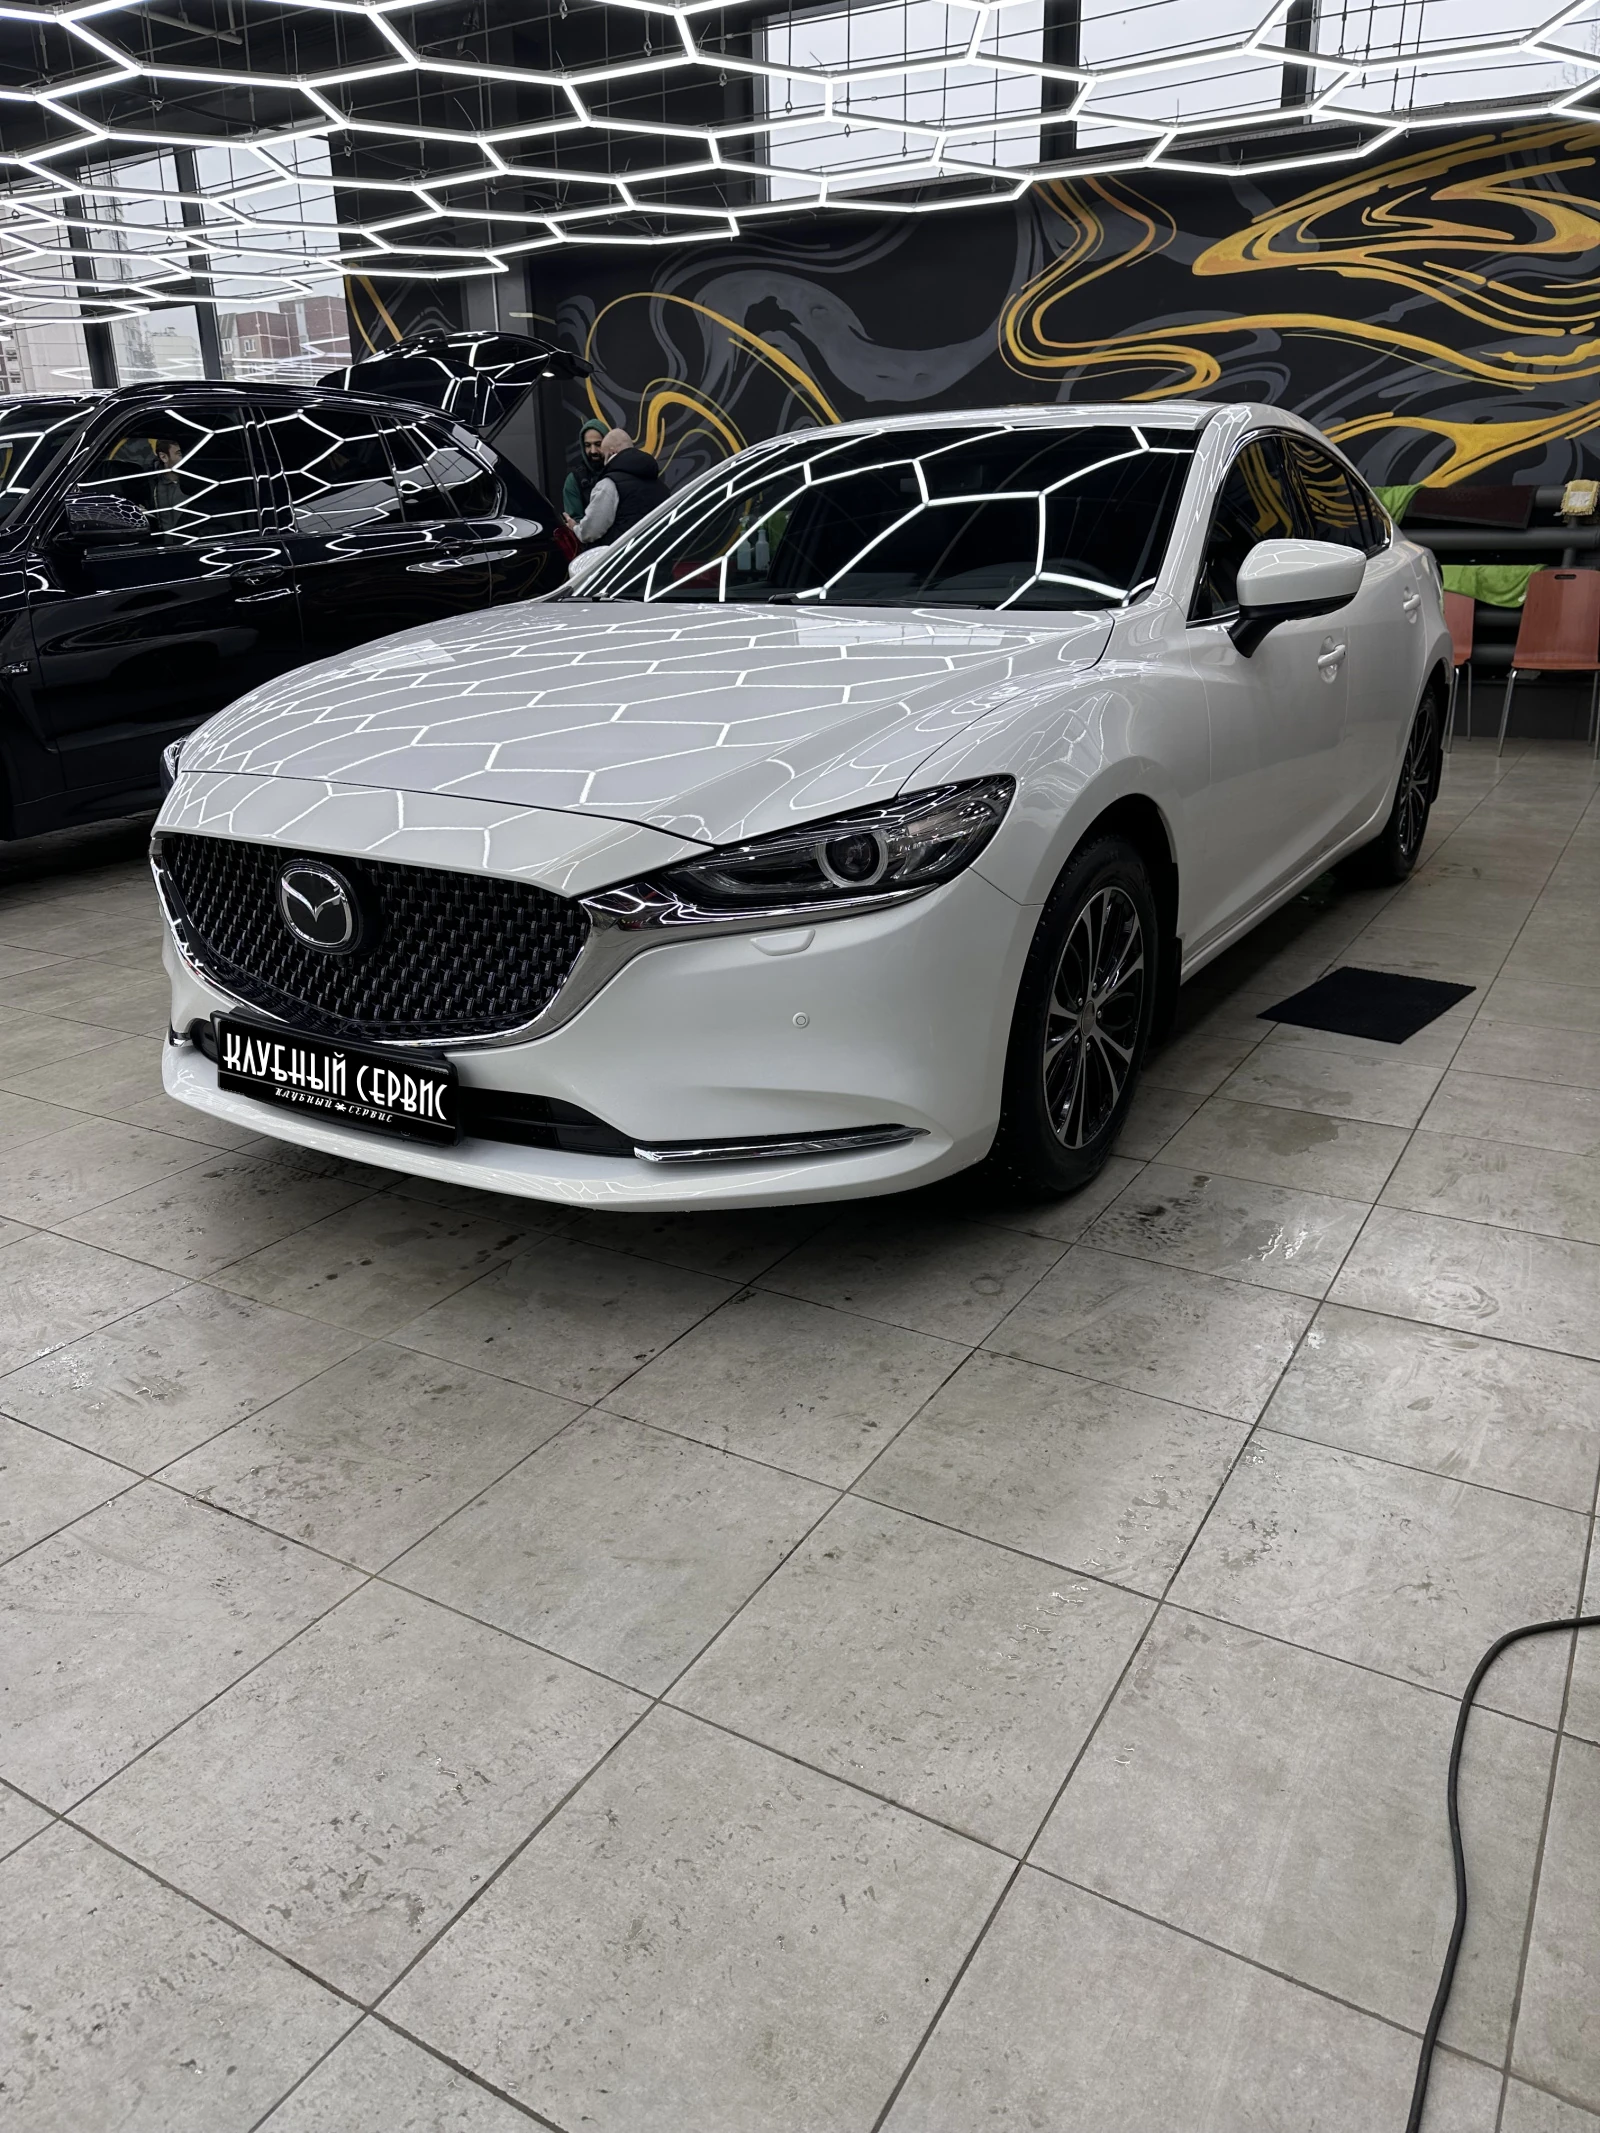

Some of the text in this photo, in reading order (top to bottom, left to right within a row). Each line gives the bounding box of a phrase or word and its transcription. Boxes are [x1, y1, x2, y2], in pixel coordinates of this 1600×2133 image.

[223, 1033, 448, 1121] КЛУБНЫЙ СЕРВИС
[348, 1105, 393, 1123] СЕРВИС
